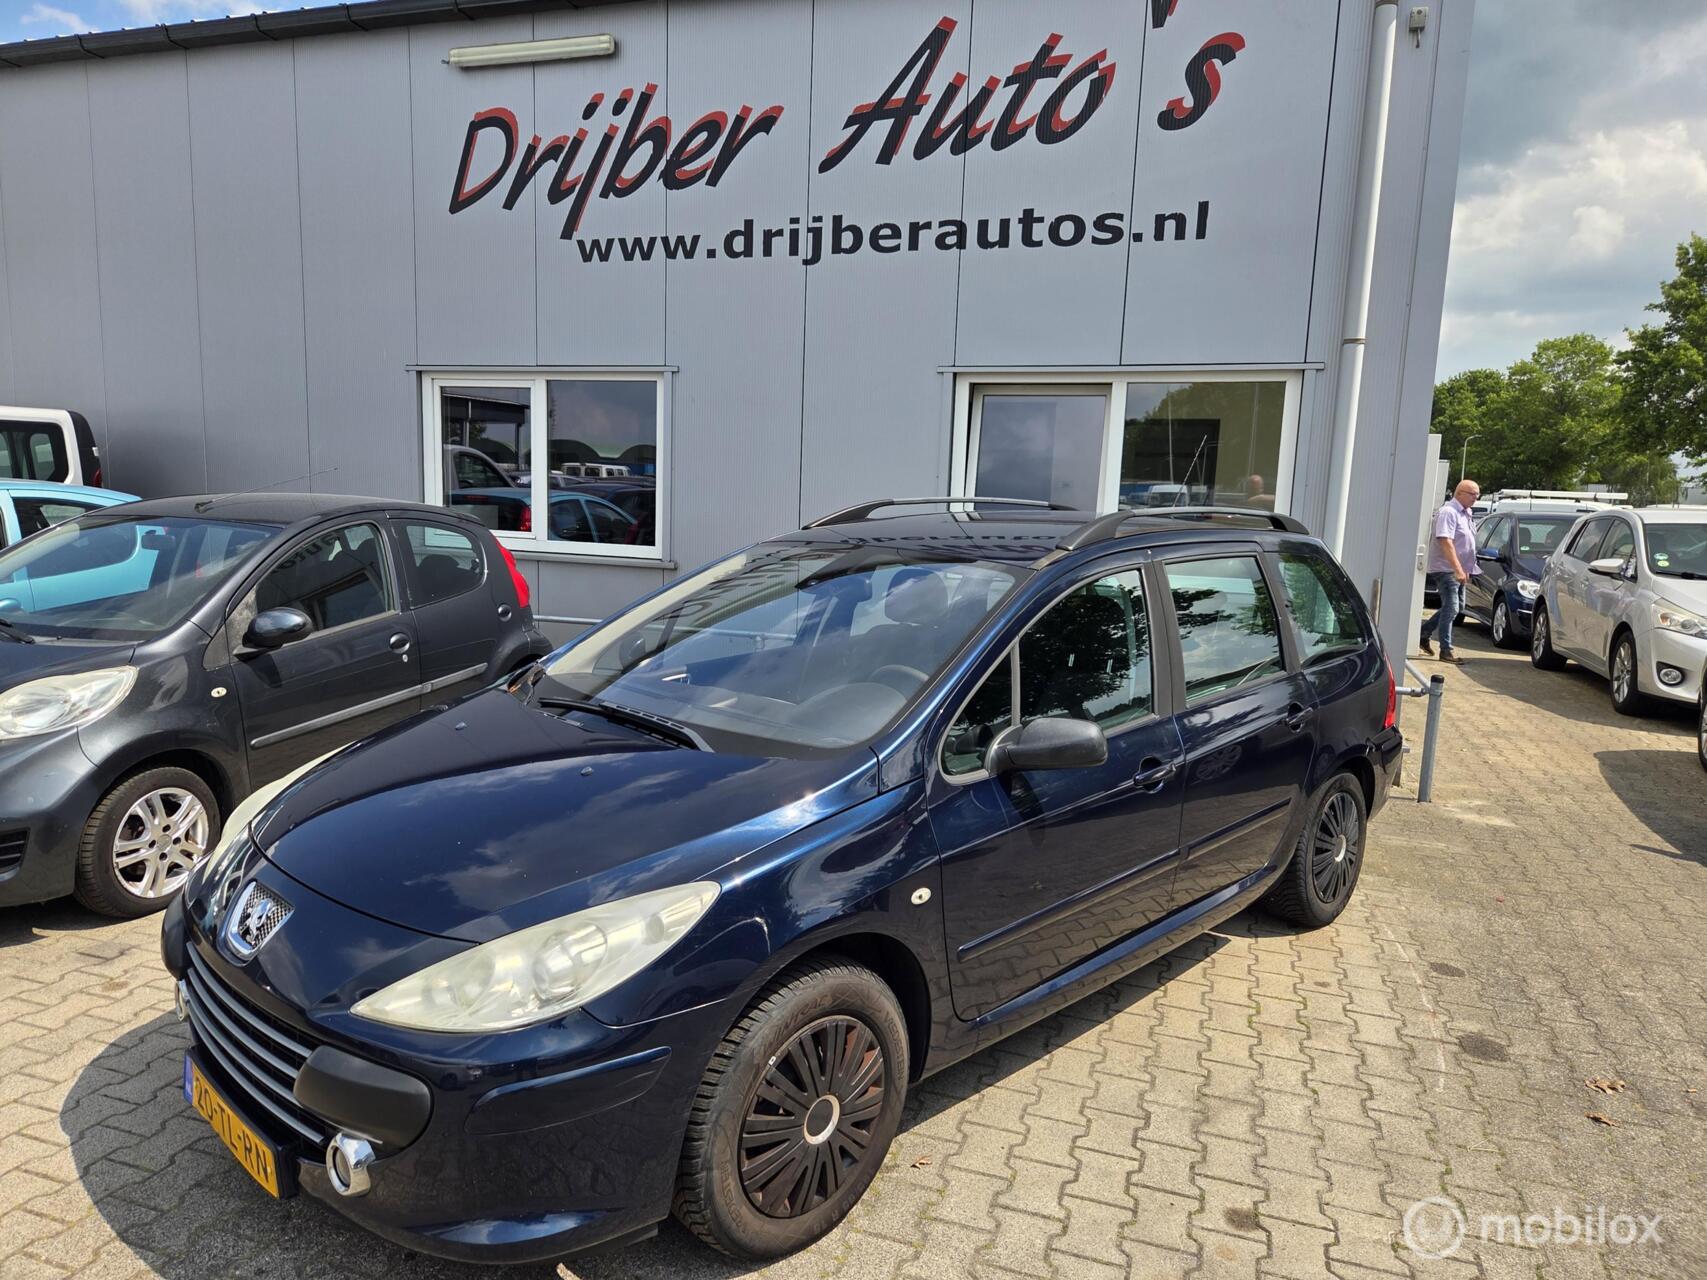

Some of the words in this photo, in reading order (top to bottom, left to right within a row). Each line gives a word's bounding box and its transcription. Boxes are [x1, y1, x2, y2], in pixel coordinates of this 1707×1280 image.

[449, 82, 784, 240] Drijber
[576, 200, 1209, 266] www.drijberautos.nl
[195, 1076, 270, 1184] 20-TL-RN
